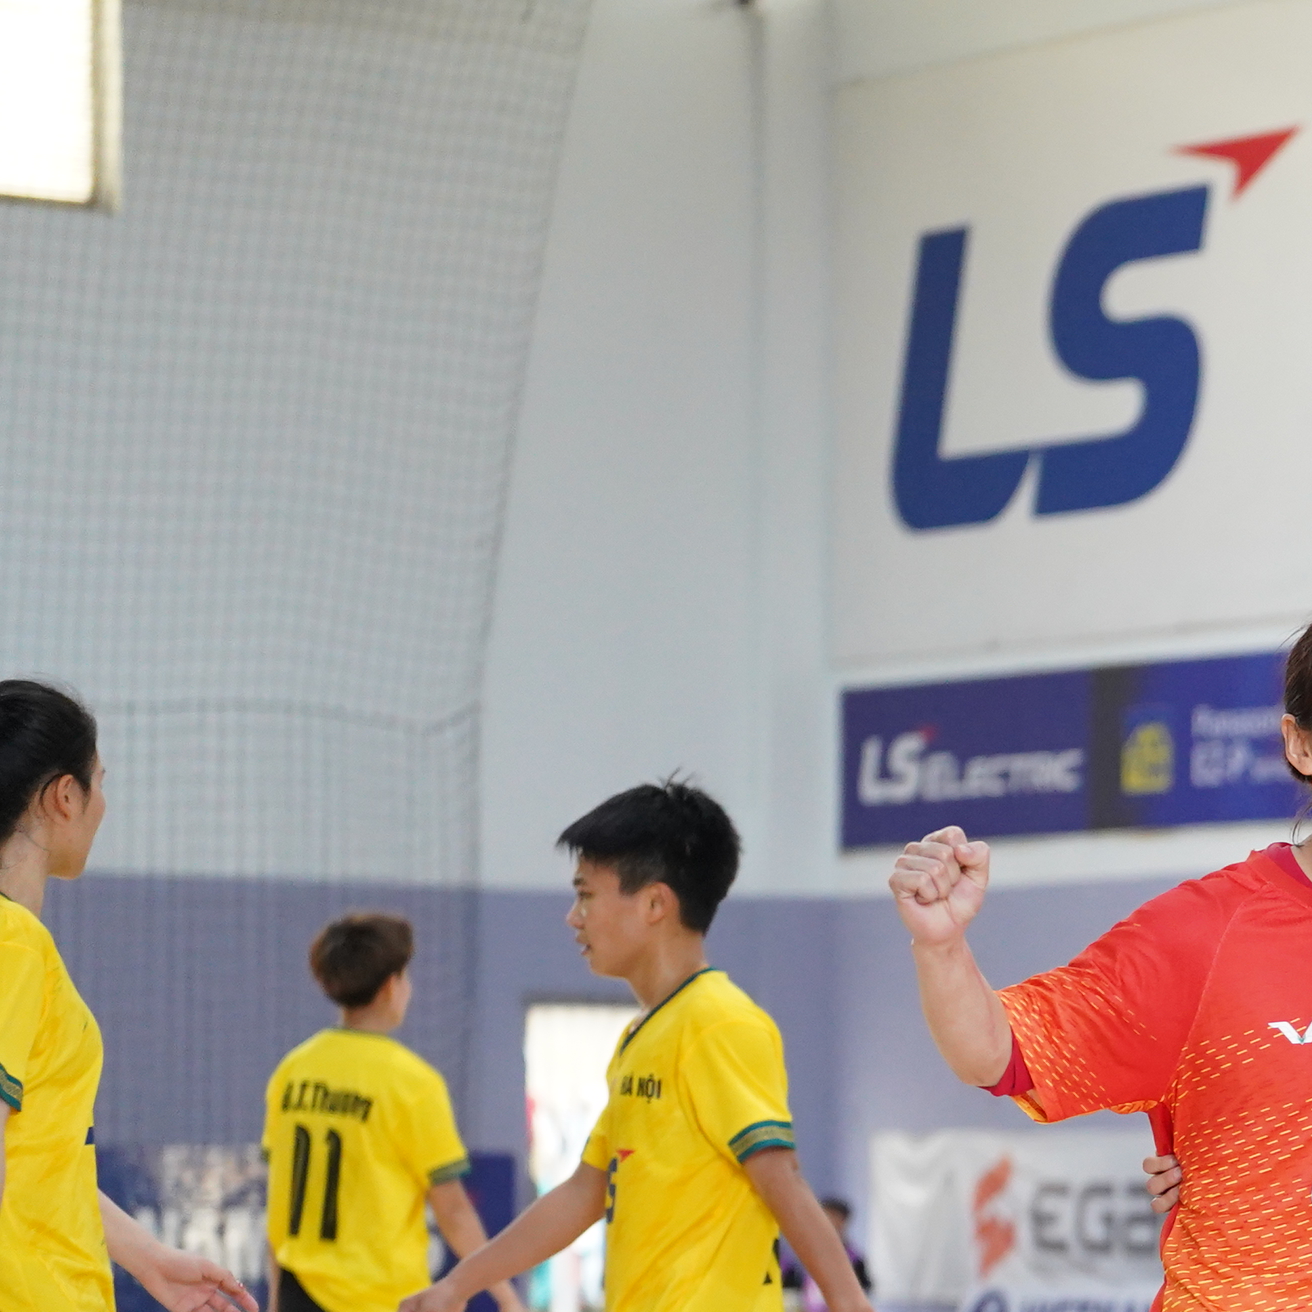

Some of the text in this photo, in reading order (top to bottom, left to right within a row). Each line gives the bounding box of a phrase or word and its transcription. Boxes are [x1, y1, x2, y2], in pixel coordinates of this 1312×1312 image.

[889, 185, 1210, 534] LS
[859, 730, 928, 807] LS
[288, 1123, 343, 1242] 11
